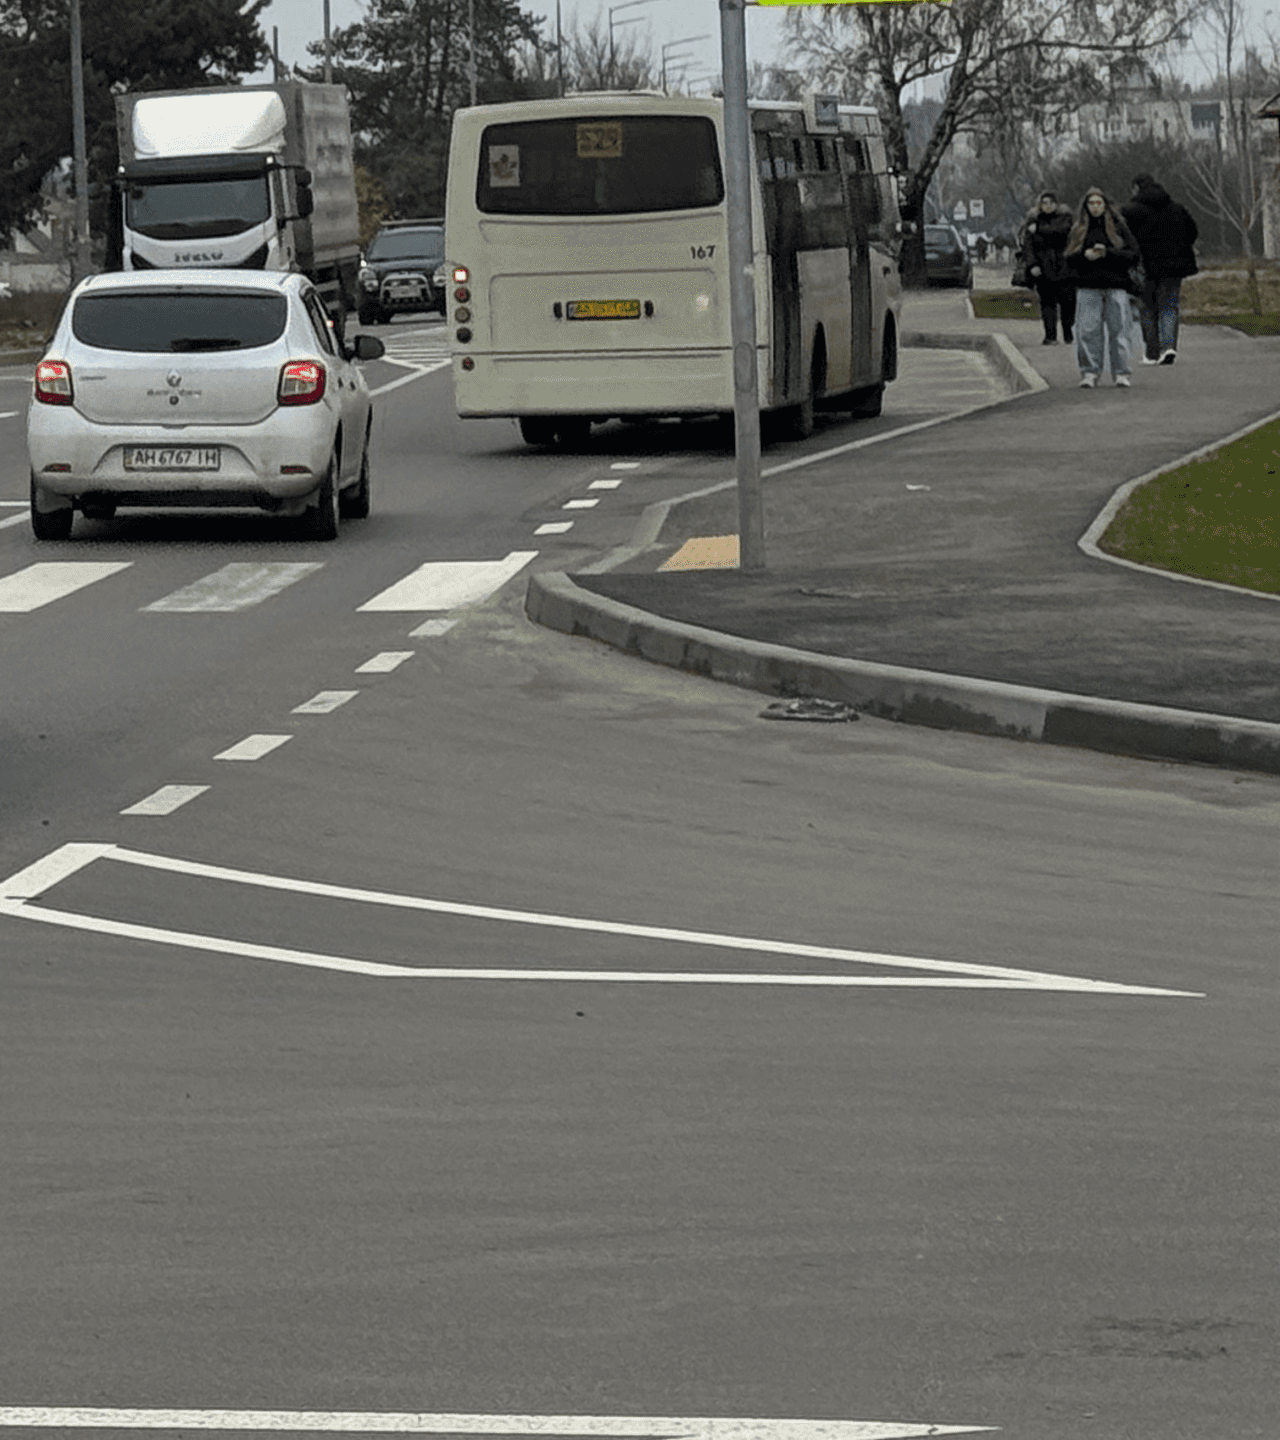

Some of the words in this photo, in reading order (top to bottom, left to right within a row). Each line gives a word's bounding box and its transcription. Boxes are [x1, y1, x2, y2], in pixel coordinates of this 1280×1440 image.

[690, 245, 716, 260] 167
[135, 449, 156, 465] AH
[158, 449, 193, 465] 6767
[198, 449, 217, 465] IH
